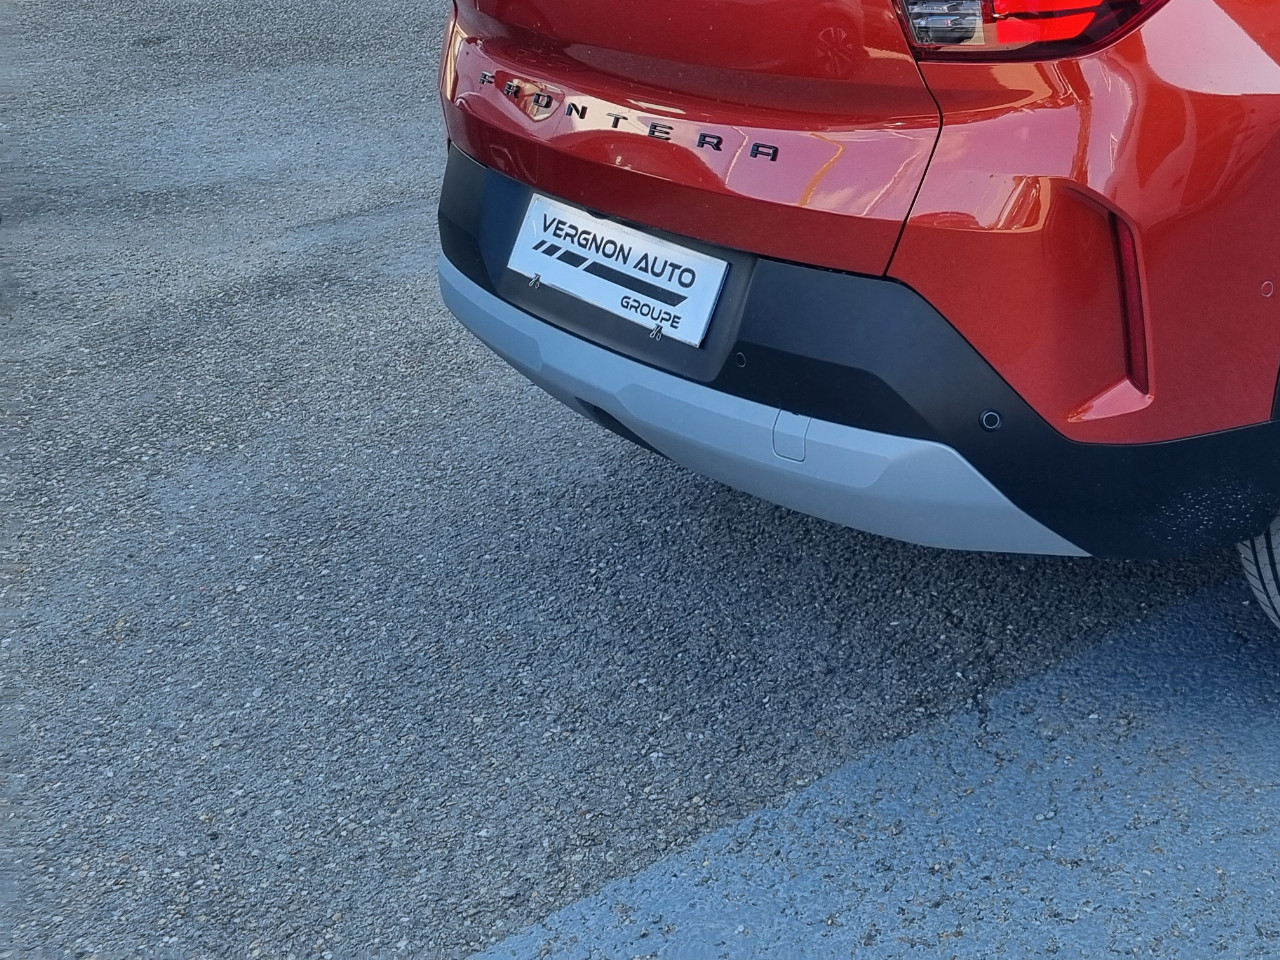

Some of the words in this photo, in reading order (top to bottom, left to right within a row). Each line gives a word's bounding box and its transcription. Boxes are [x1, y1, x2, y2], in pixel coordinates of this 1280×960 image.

[479, 71, 779, 163] FRONTERA
[541, 212, 632, 264] VERGNON
[633, 251, 697, 290] AUTO
[620, 294, 682, 330] GROUPE
